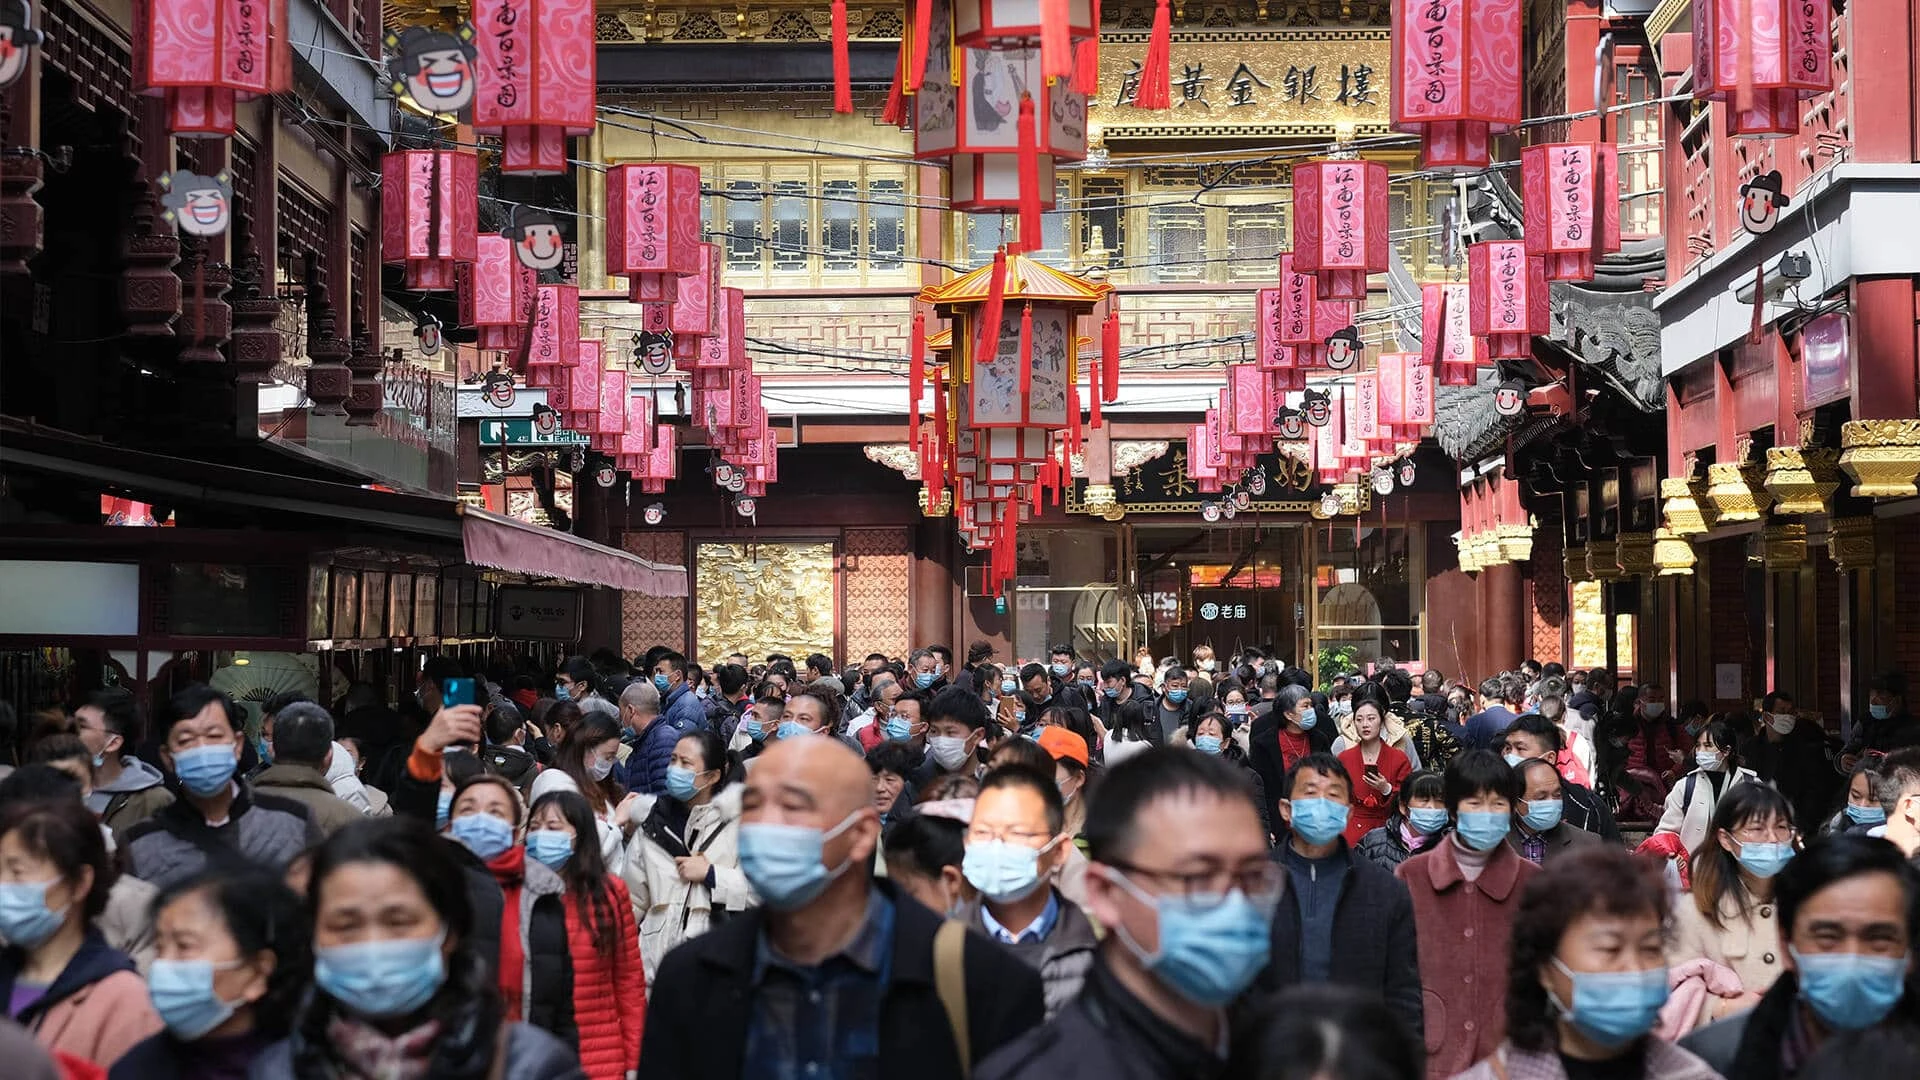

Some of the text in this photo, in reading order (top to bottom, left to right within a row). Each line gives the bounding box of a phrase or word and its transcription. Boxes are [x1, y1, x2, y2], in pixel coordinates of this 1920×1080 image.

[639, 170, 657, 261] 江南百景图
[1335, 166, 1354, 258] 江南百景图
[1561, 149, 1582, 241] 江南百景图
[1500, 246, 1517, 324] 江南百景图
[1221, 604, 1247, 619] 老庙
